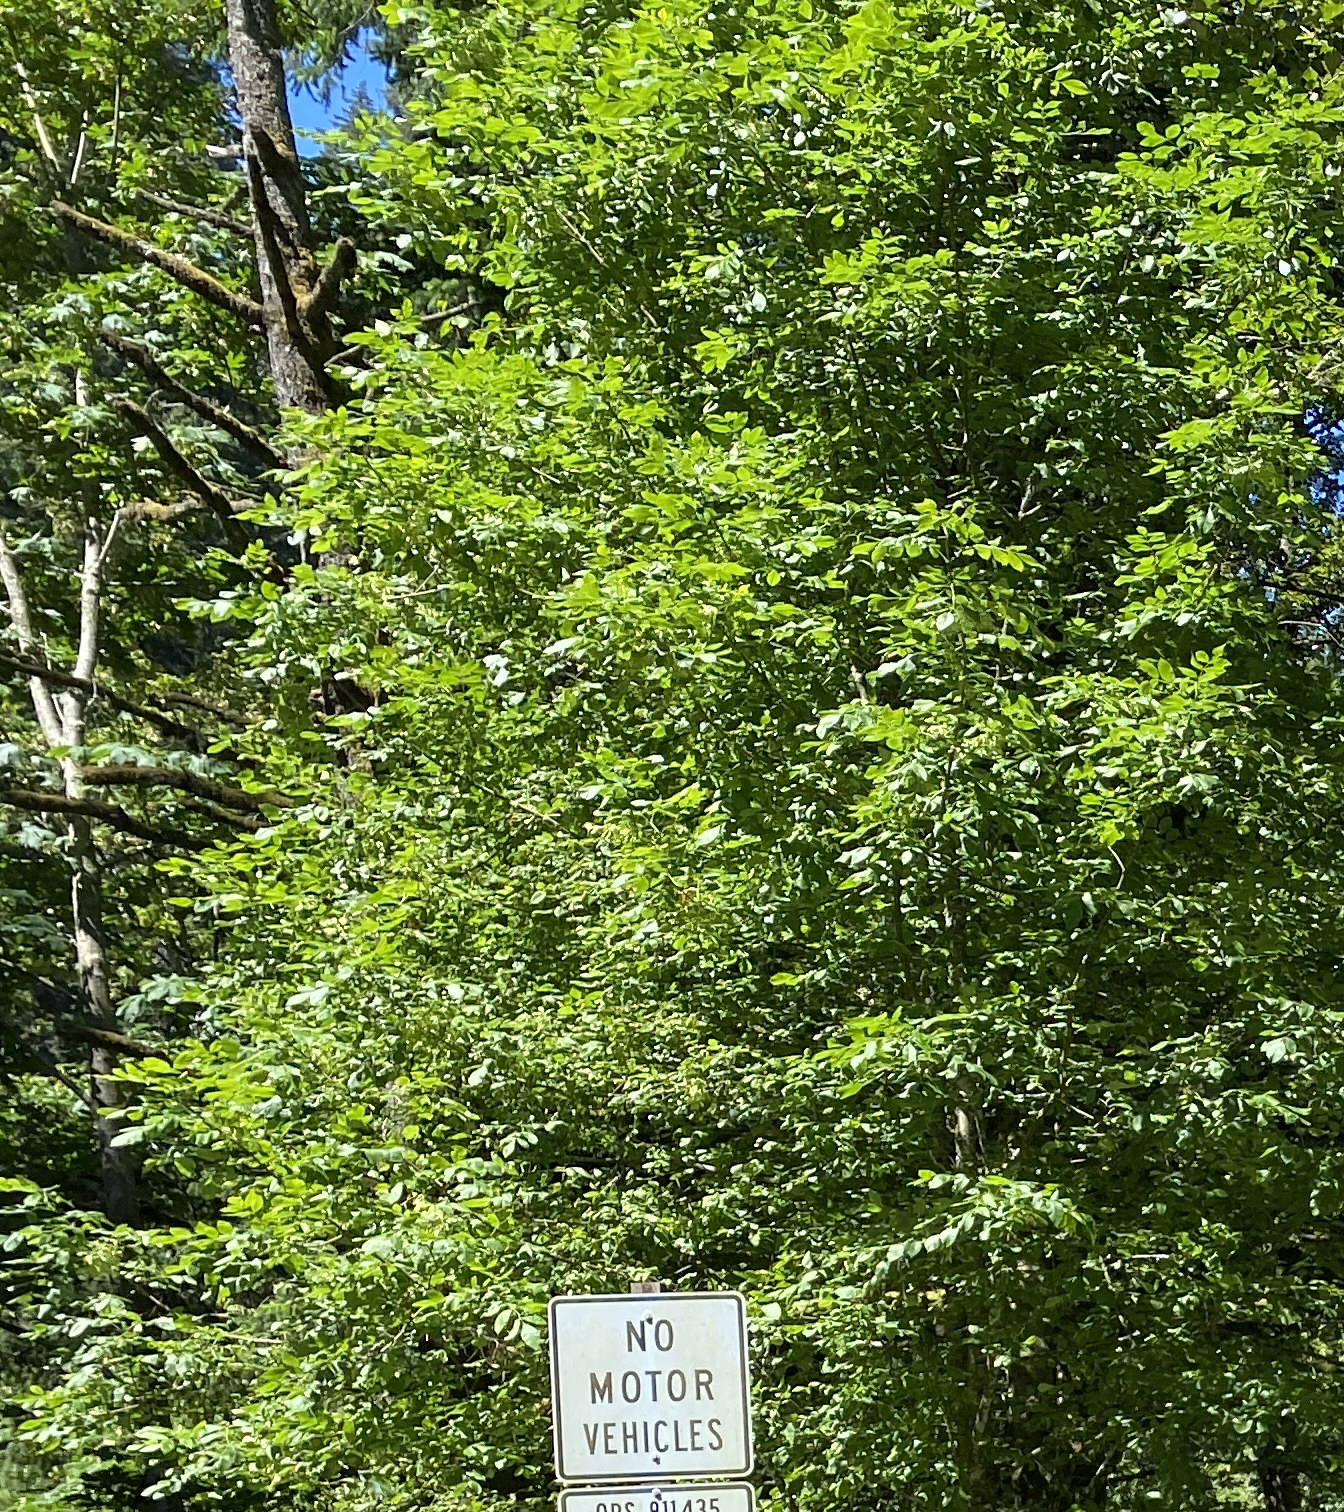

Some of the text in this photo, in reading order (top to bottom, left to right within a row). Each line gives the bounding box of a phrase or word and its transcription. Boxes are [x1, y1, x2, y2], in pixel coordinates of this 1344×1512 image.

[626, 1319, 674, 1352] NO
[589, 1368, 714, 1405] MOTOR
[583, 1418, 723, 1456] VEHICLES
